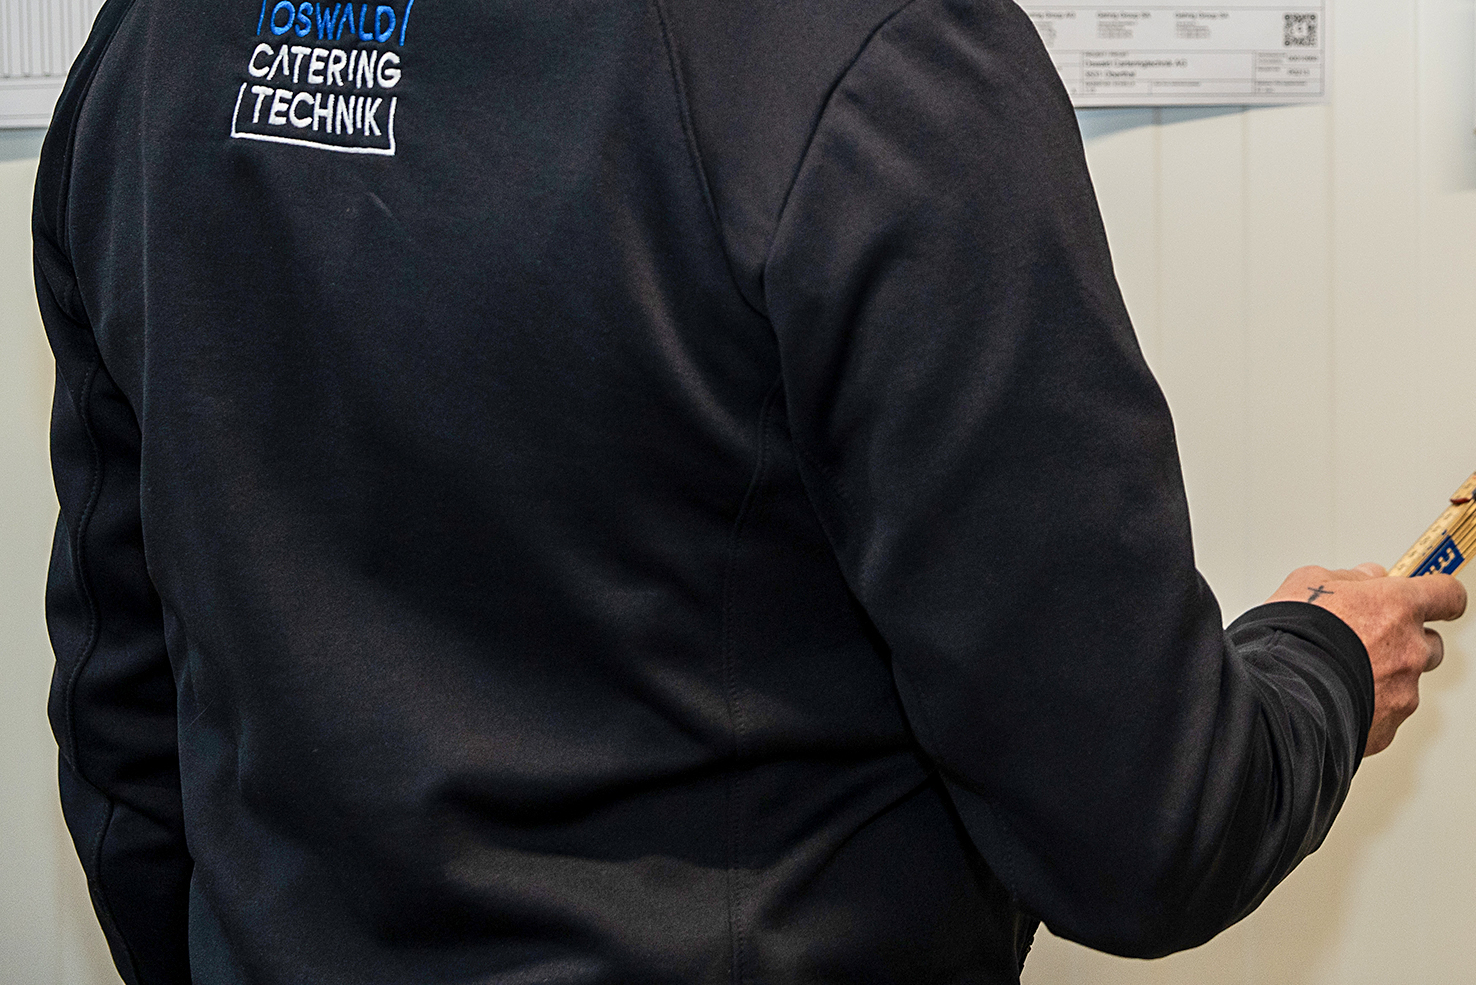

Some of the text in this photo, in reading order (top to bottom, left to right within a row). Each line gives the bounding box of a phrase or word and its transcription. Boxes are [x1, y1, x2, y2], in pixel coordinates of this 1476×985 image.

[270, 0, 396, 43] OSWALD
[248, 43, 401, 89] CATERING
[251, 85, 382, 136] TECHNIK
